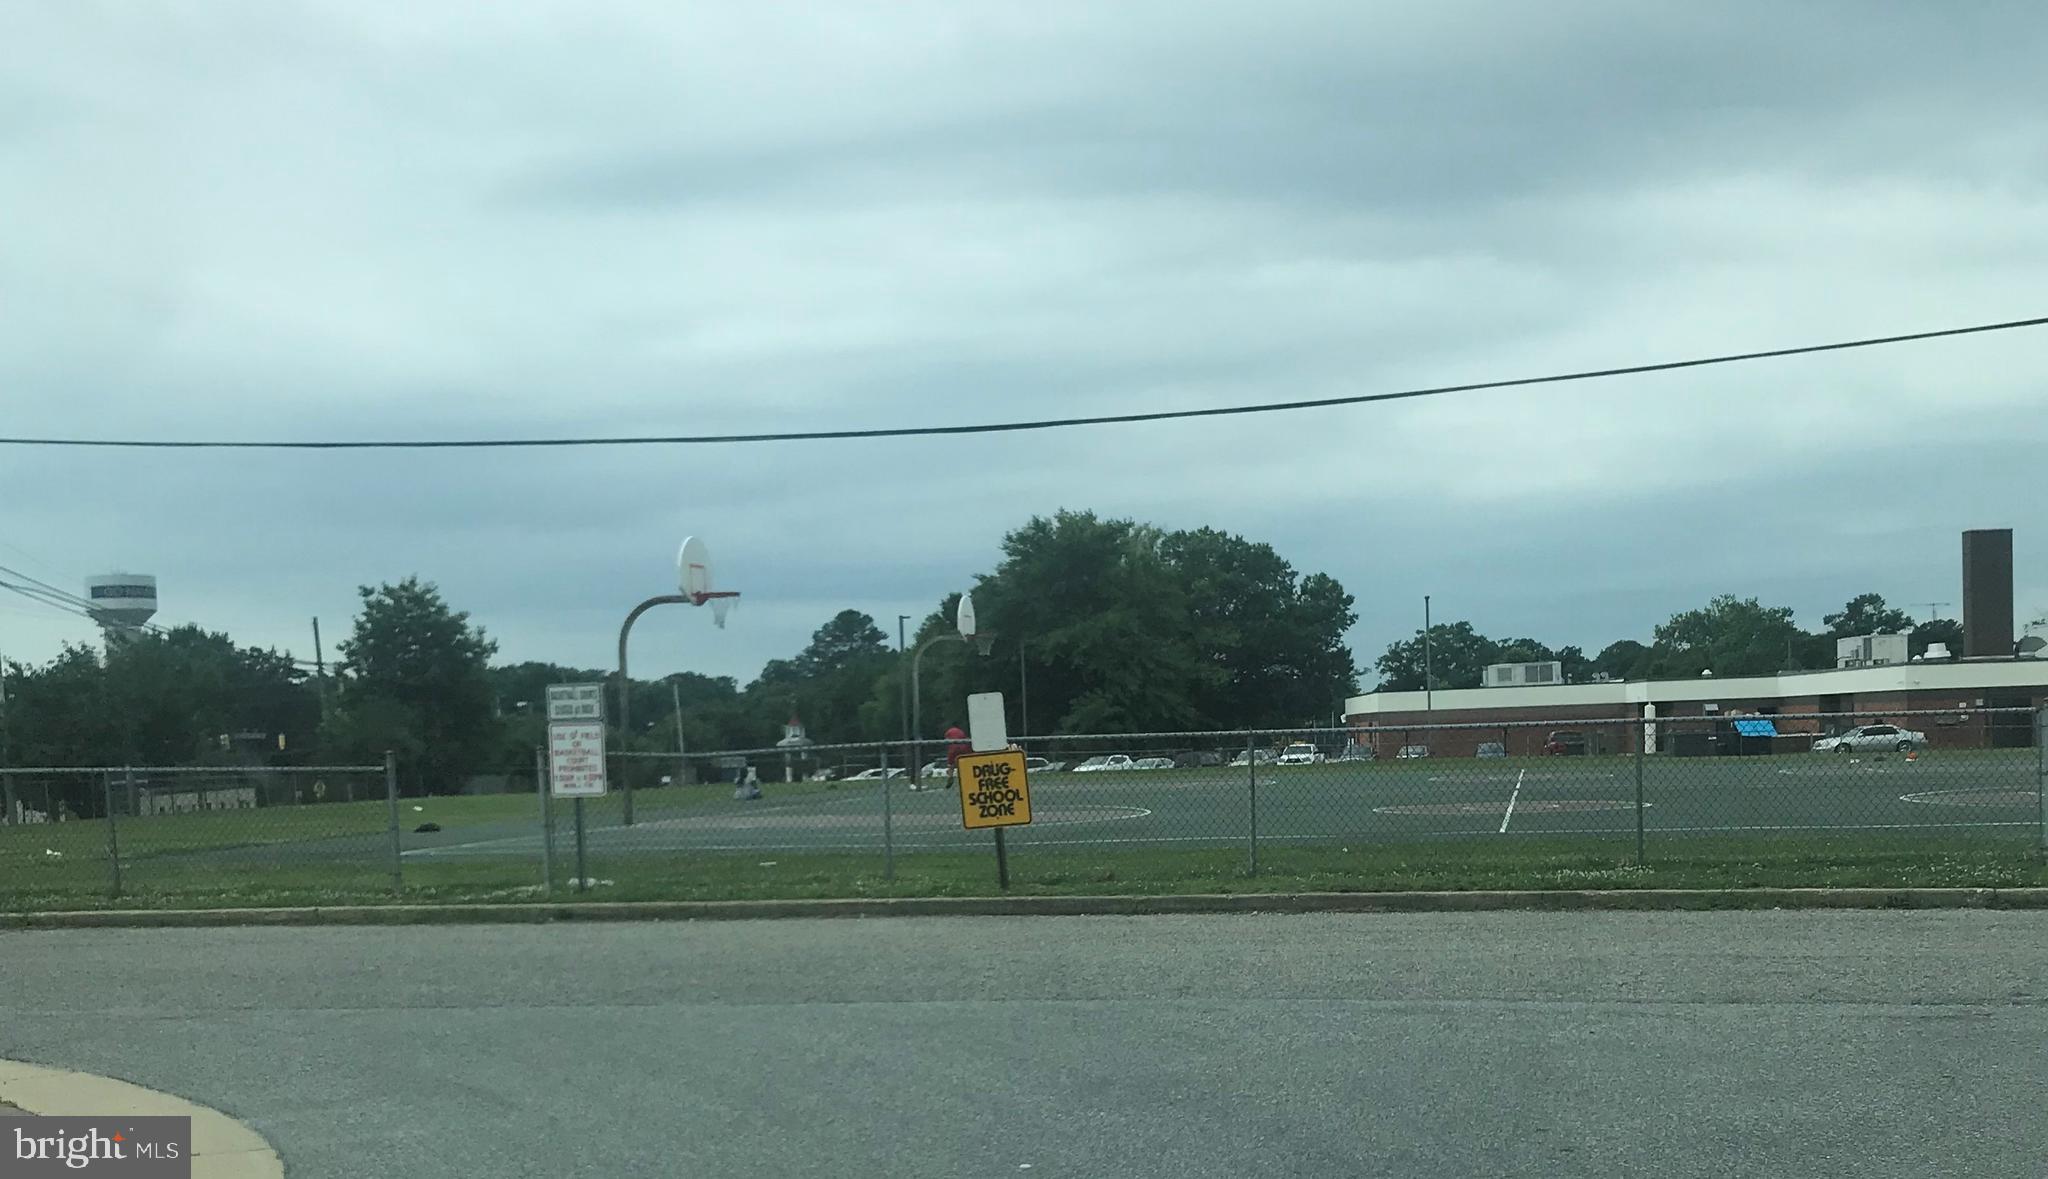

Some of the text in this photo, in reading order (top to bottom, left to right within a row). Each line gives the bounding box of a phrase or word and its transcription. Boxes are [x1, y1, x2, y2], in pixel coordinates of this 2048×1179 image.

[972, 762, 1016, 778] DRUG-
[978, 776, 1009, 791] FREE
[968, 789, 1024, 806] SCHOOL
[979, 803, 1015, 818] ZONE
